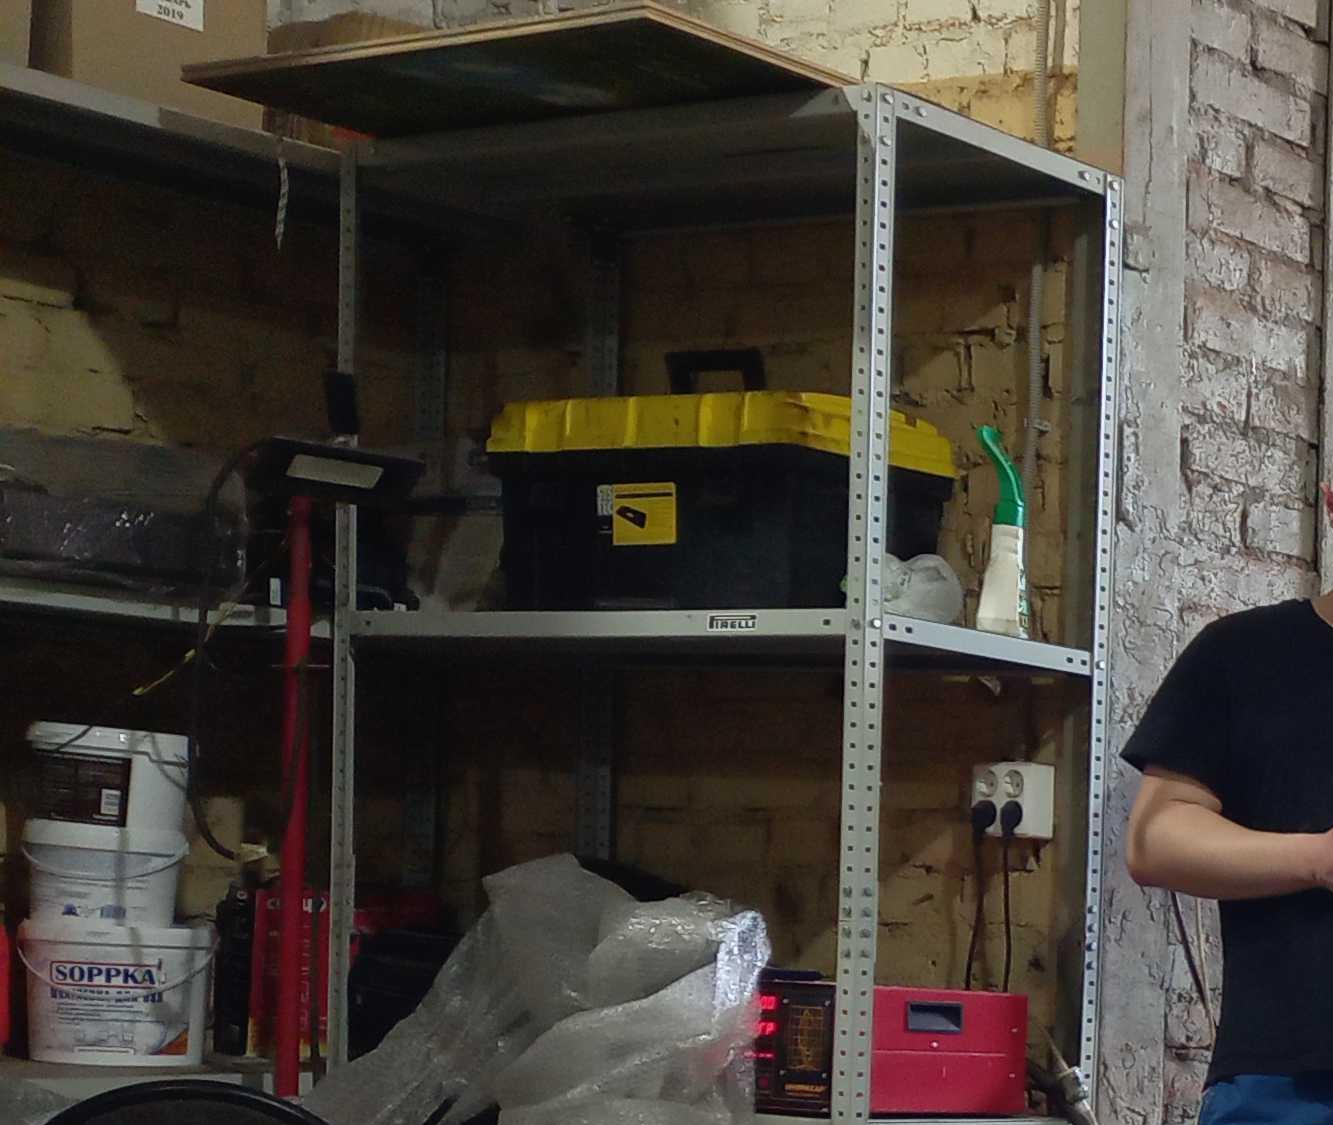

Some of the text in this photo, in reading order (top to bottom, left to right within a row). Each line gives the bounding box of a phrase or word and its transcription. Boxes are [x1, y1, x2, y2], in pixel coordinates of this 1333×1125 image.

[157, 5, 184, 19] 2019
[709, 614, 757, 629] PIRELLI
[55, 964, 156, 985] SOPPKA
